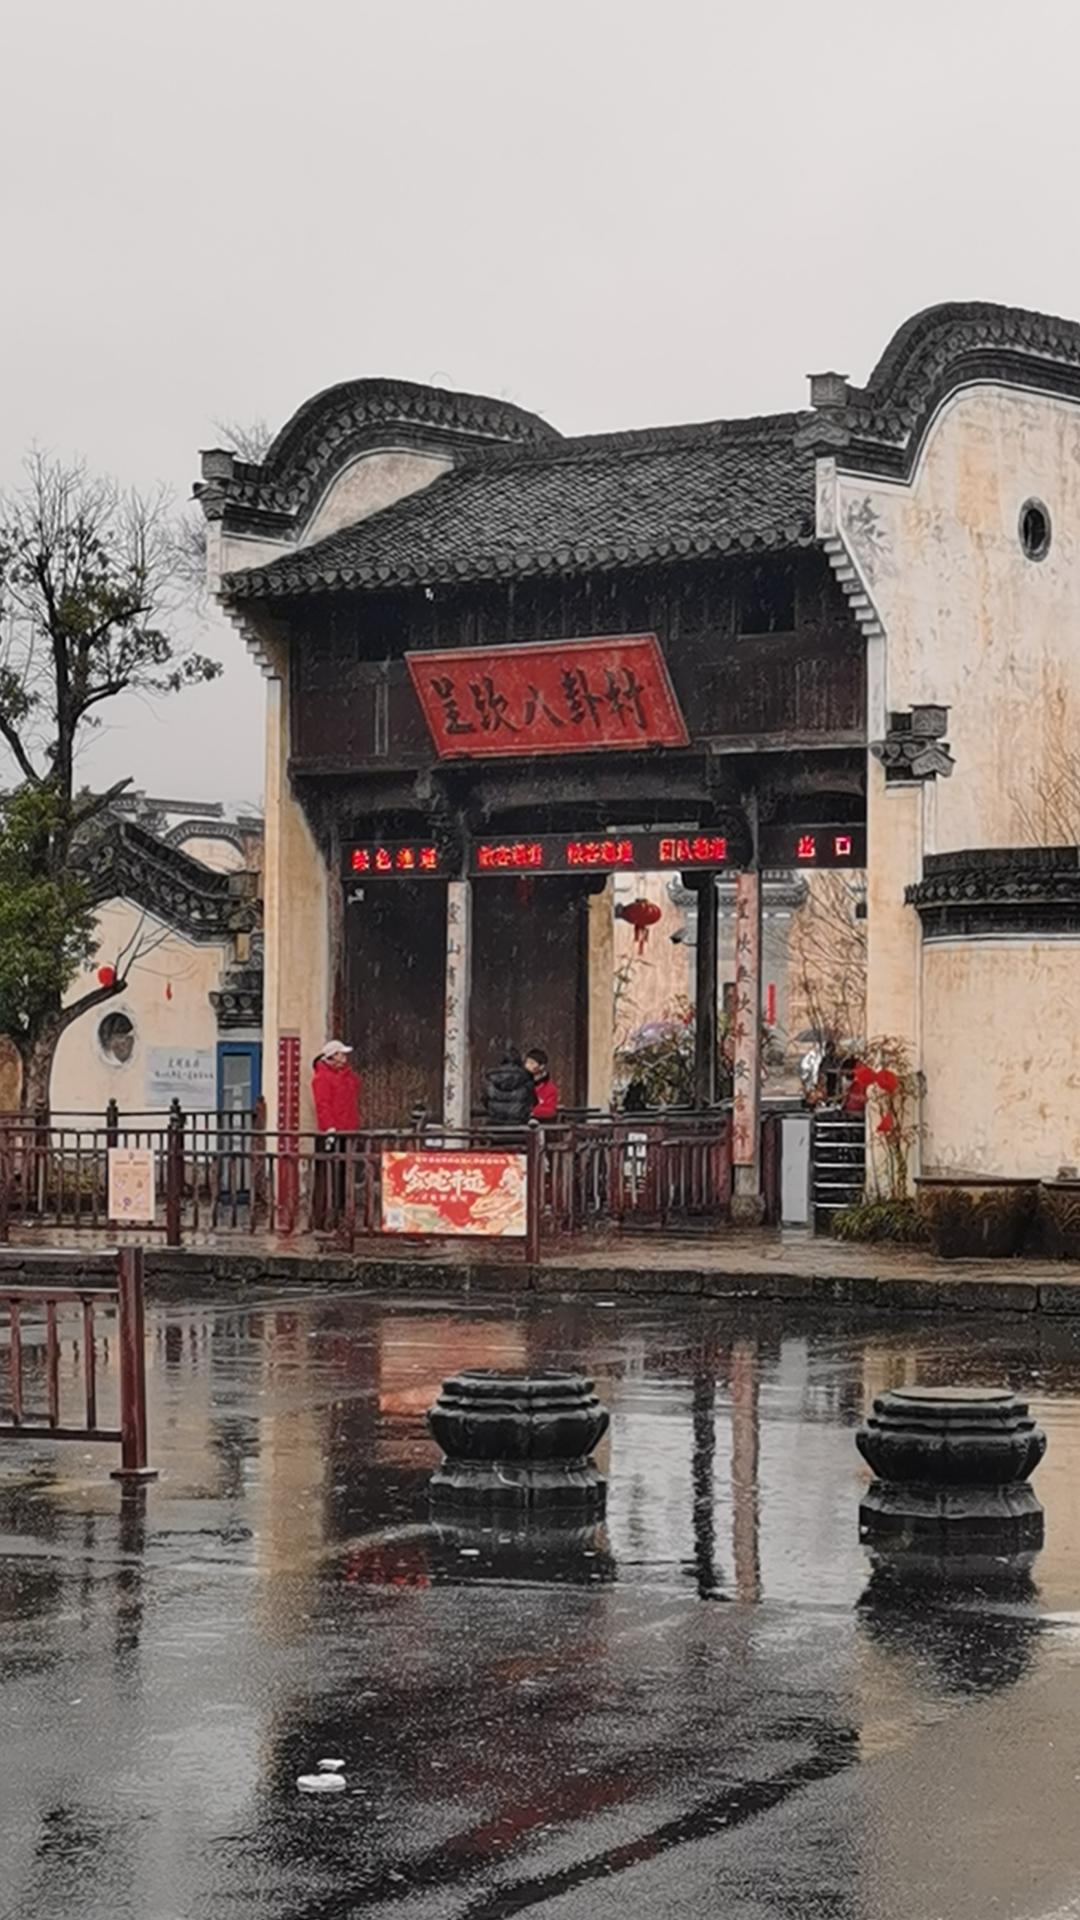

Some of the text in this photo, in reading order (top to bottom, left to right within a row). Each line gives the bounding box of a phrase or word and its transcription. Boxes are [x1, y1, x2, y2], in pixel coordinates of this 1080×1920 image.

[430, 666, 645, 735] 呈坎八卦村
[798, 836, 851, 857] 出口
